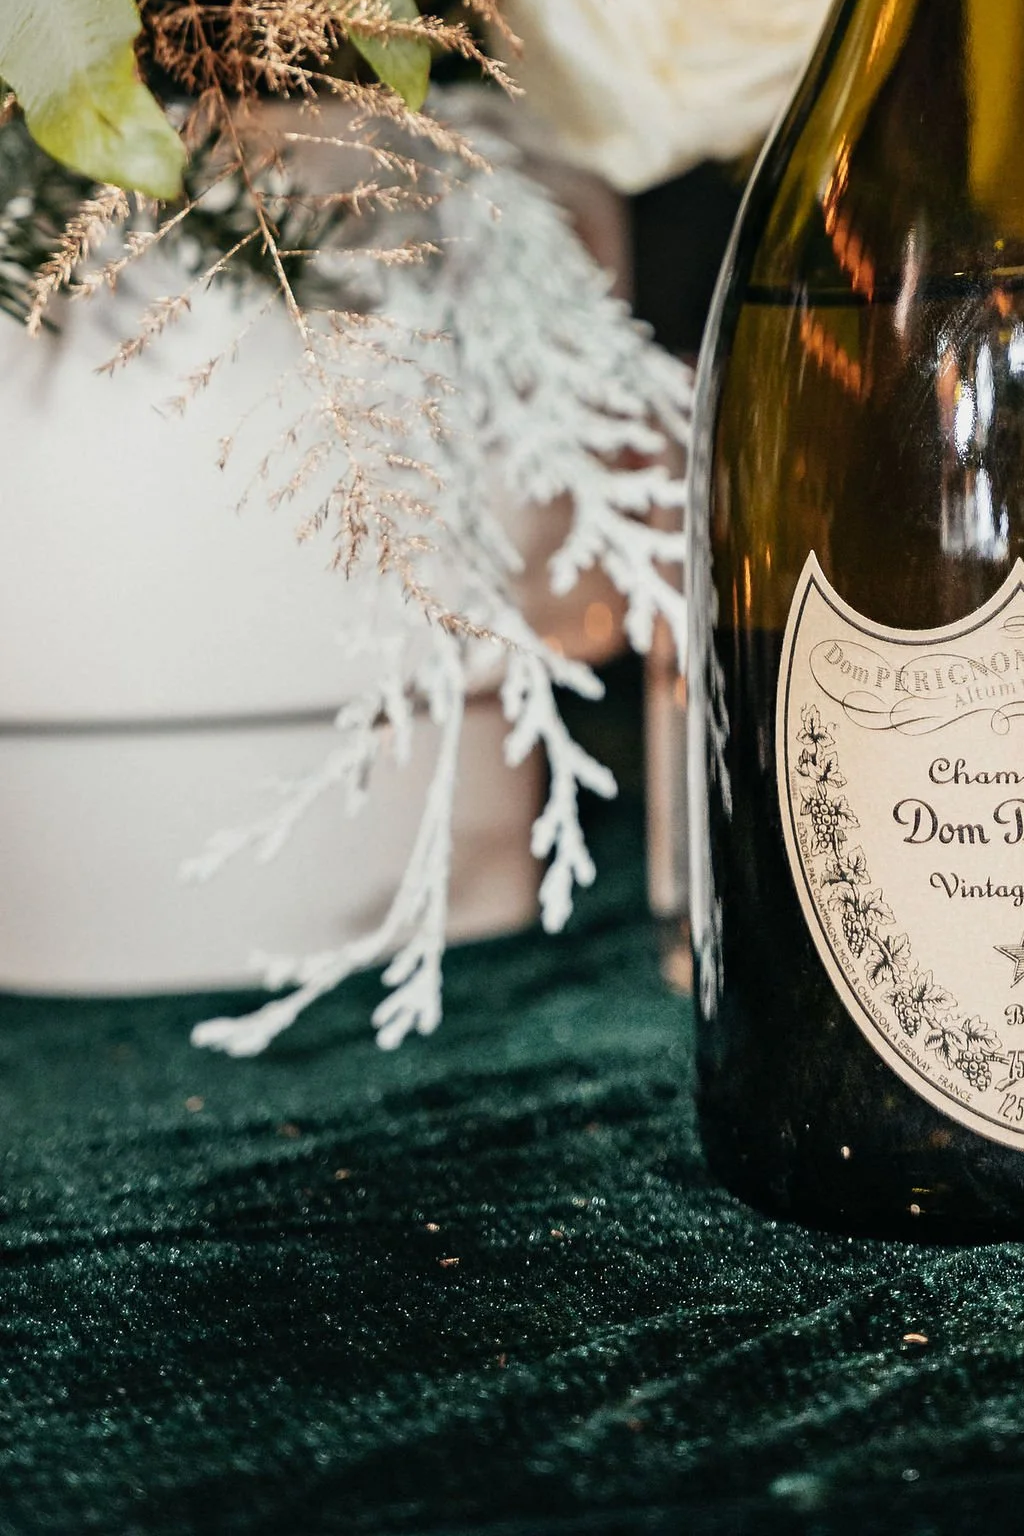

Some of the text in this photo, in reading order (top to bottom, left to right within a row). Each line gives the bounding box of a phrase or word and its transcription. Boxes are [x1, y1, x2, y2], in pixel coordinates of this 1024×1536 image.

[824, 642, 869, 684] Dom
[955, 682, 1016, 708] Altum
[892, 797, 990, 845] Dom
[808, 868, 818, 886] PAR
[813, 888, 838, 948] CHAMPAGNE
[852, 977, 860, 986] &
[858, 984, 894, 1033] CHANDON
[938, 1075, 974, 1104] FRANCE
